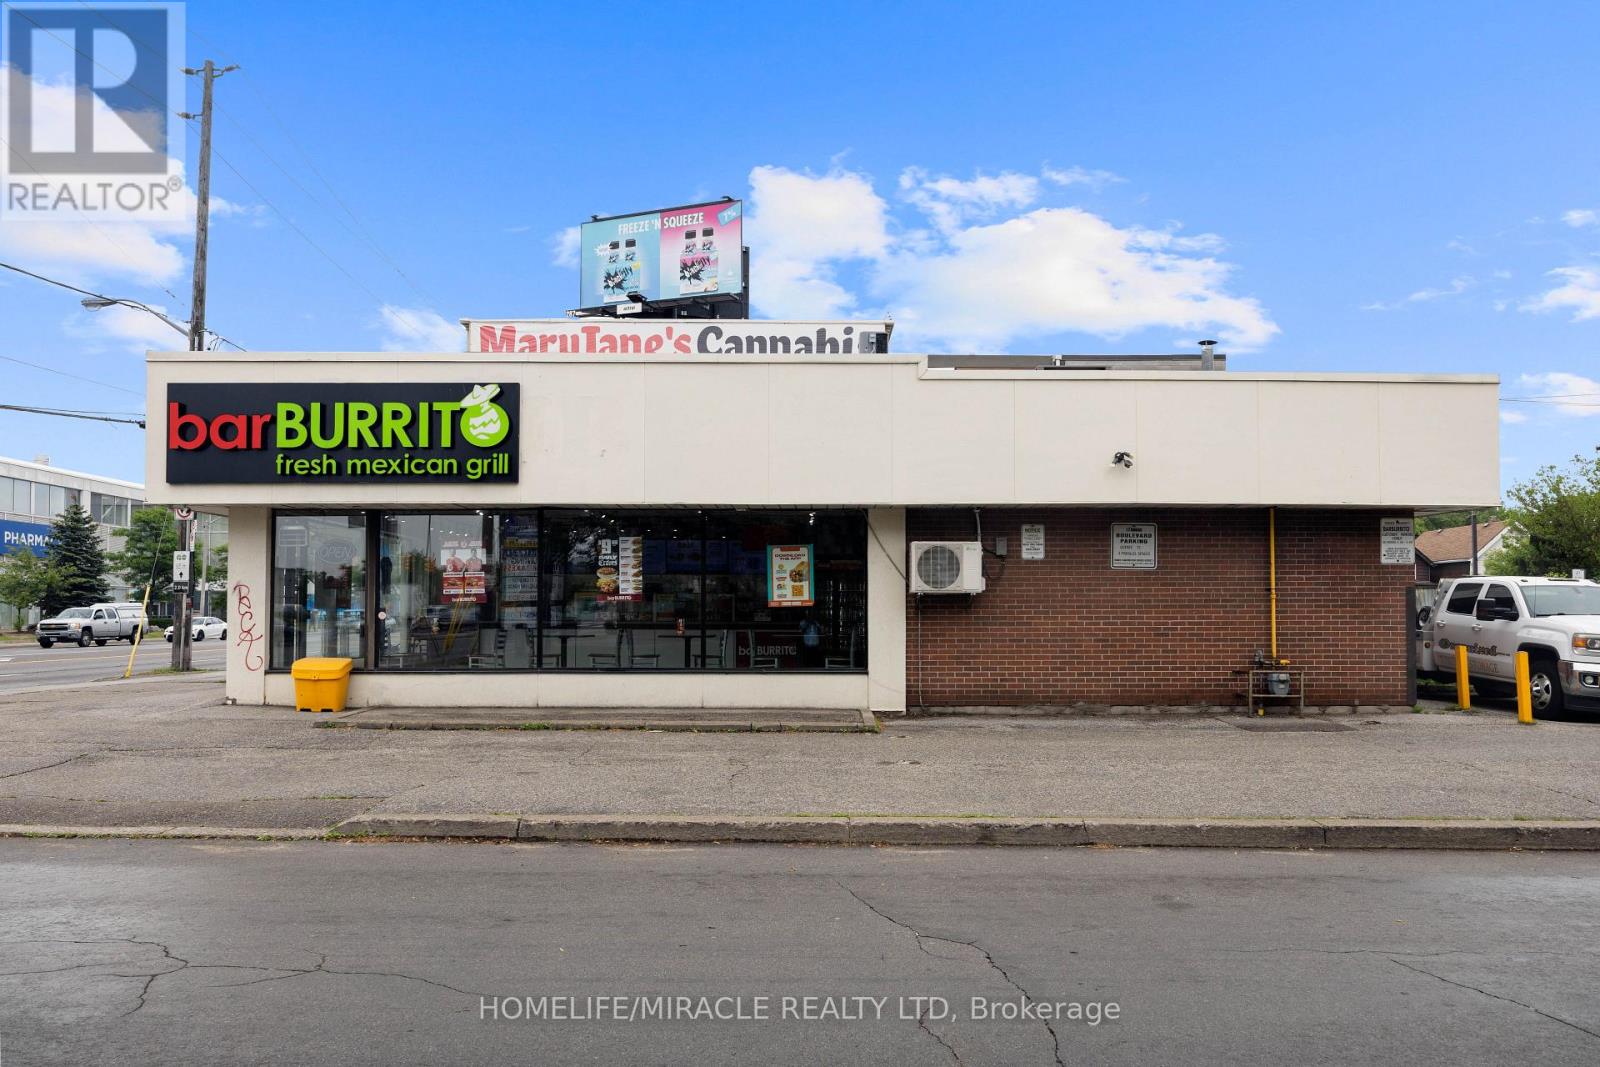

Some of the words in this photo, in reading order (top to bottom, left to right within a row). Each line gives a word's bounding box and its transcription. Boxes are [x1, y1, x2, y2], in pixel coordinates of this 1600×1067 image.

[618, 220, 650, 235] FREEZE
[663, 212, 704, 229] SQUEEZE
[697, 325, 854, 354] Cannabi
[276, 454, 337, 475] fresh
[347, 454, 457, 475] mexican
[466, 453, 509, 480] grill
[4, 531, 62, 547] PHARMA
[320, 546, 351, 559] OPEN
